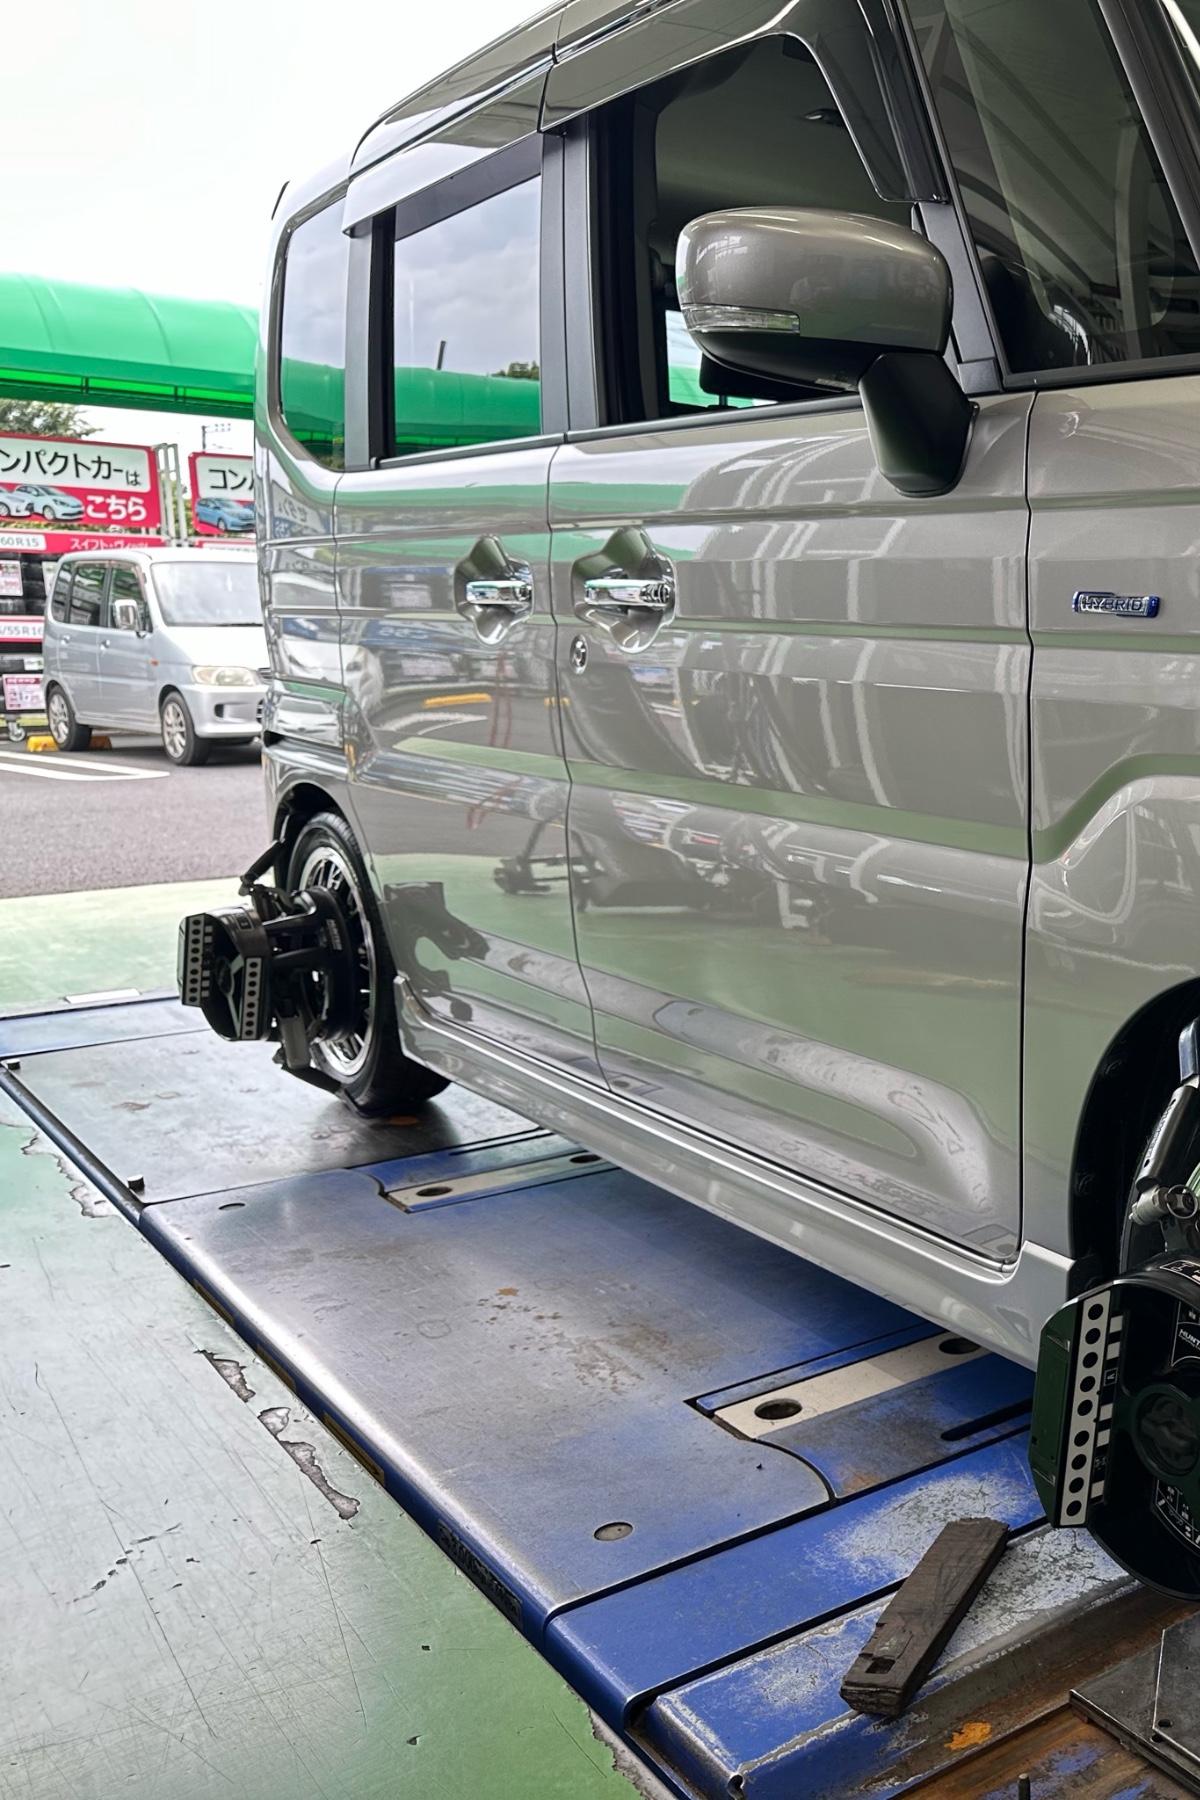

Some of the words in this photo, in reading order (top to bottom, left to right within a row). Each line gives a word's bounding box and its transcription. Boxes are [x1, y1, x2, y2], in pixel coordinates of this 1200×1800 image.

[0, 449, 141, 486] ンパクトカーは
[86, 494, 147, 521] こちら
[1081, 596, 1144, 612] HYBRID
